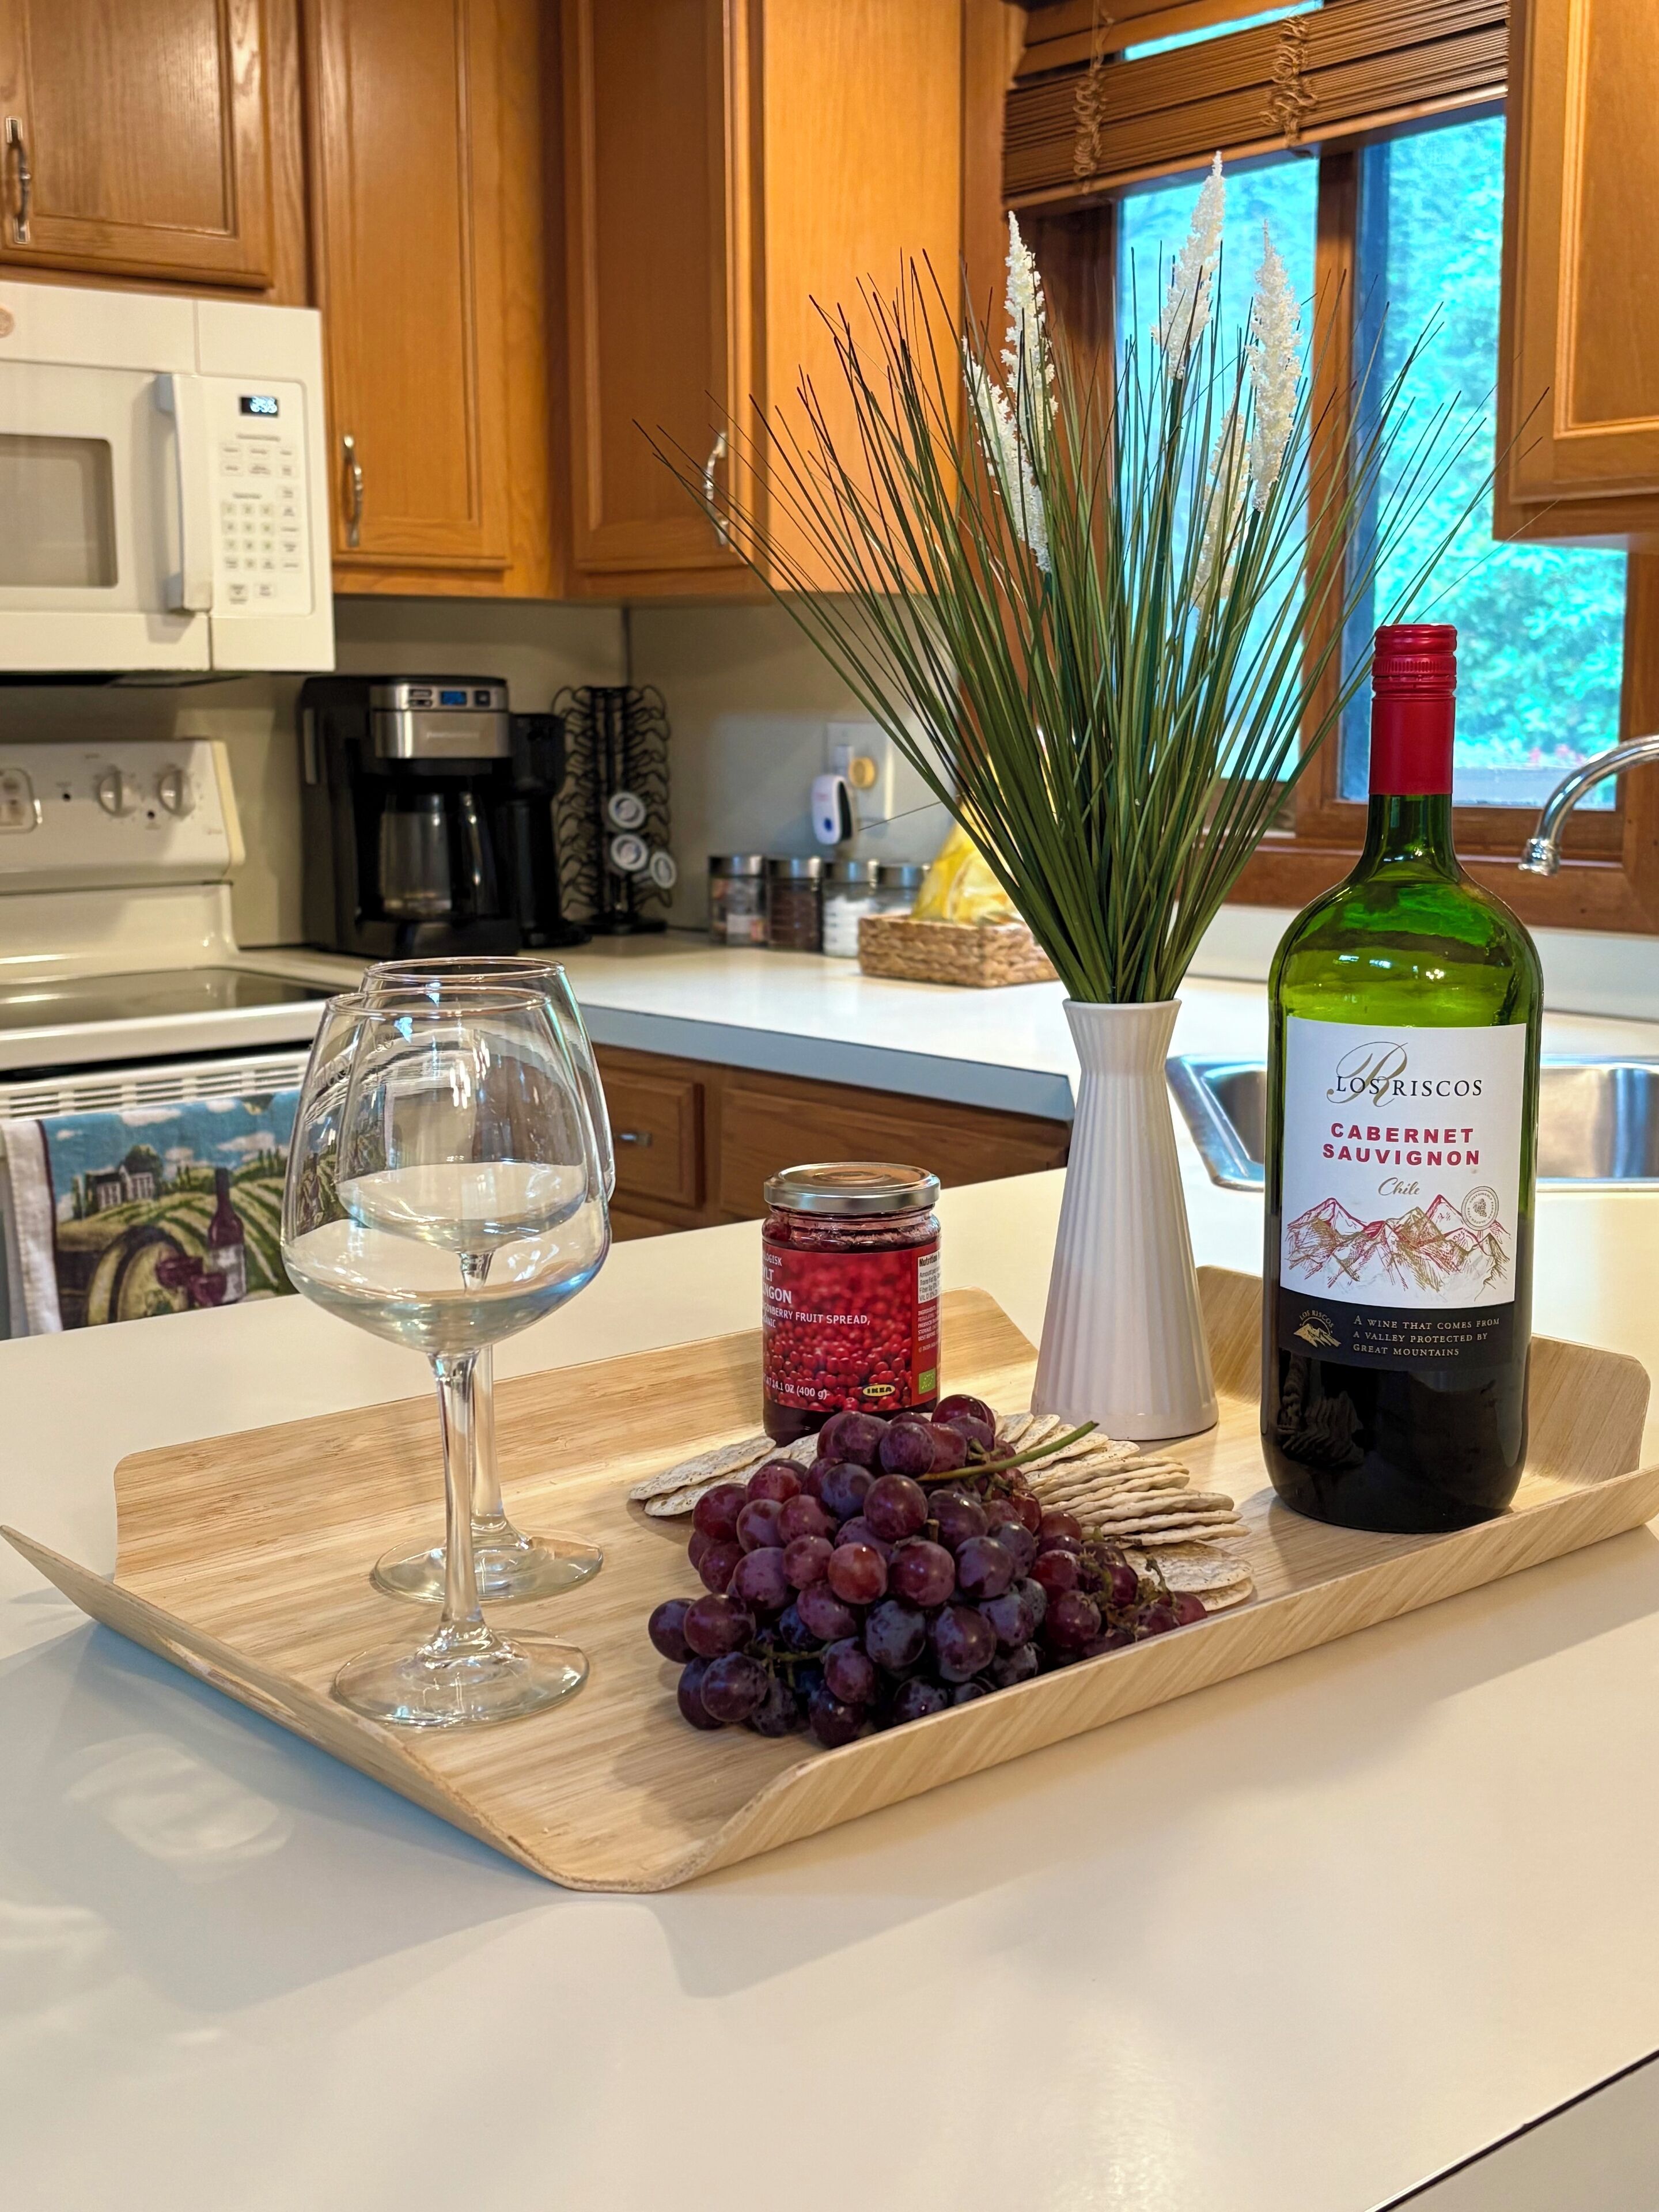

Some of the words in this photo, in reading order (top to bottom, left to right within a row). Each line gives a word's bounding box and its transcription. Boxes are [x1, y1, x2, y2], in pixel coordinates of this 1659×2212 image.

[1336, 1076, 1380, 1094] LOS
[1392, 1080, 1482, 1096] RISCOS
[1331, 1123, 1474, 1143] CABERNET
[1323, 1143, 1479, 1166] SAUVIGNON
[1377, 1177, 1420, 1195] Chile
[796, 1312, 824, 1323] FRUIT
[826, 1315, 870, 1325] SPREAD,
[1300, 1310, 1310, 1320] LOS
[1312, 1310, 1334, 1328] RISCOS
[1354, 1315, 1362, 1325] A
[1367, 1319, 1397, 1328] WINE
[1437, 1321, 1472, 1330] COMES
[1476, 1318, 1499, 1328] FROM
[1365, 1332, 1405, 1342] VALLEY
[1410, 1334, 1473, 1343] PROTECTED
[1477, 1332, 1488, 1340] BY
[1353, 1344, 1388, 1354] GREAT
[1393, 1347, 1459, 1357] MOUNTAINS
[772, 1379, 783, 1391] 14.1
[785, 1383, 795, 1394] OZ
[797, 1385, 815, 1397] (400
[818, 1388, 828, 1400] g)
